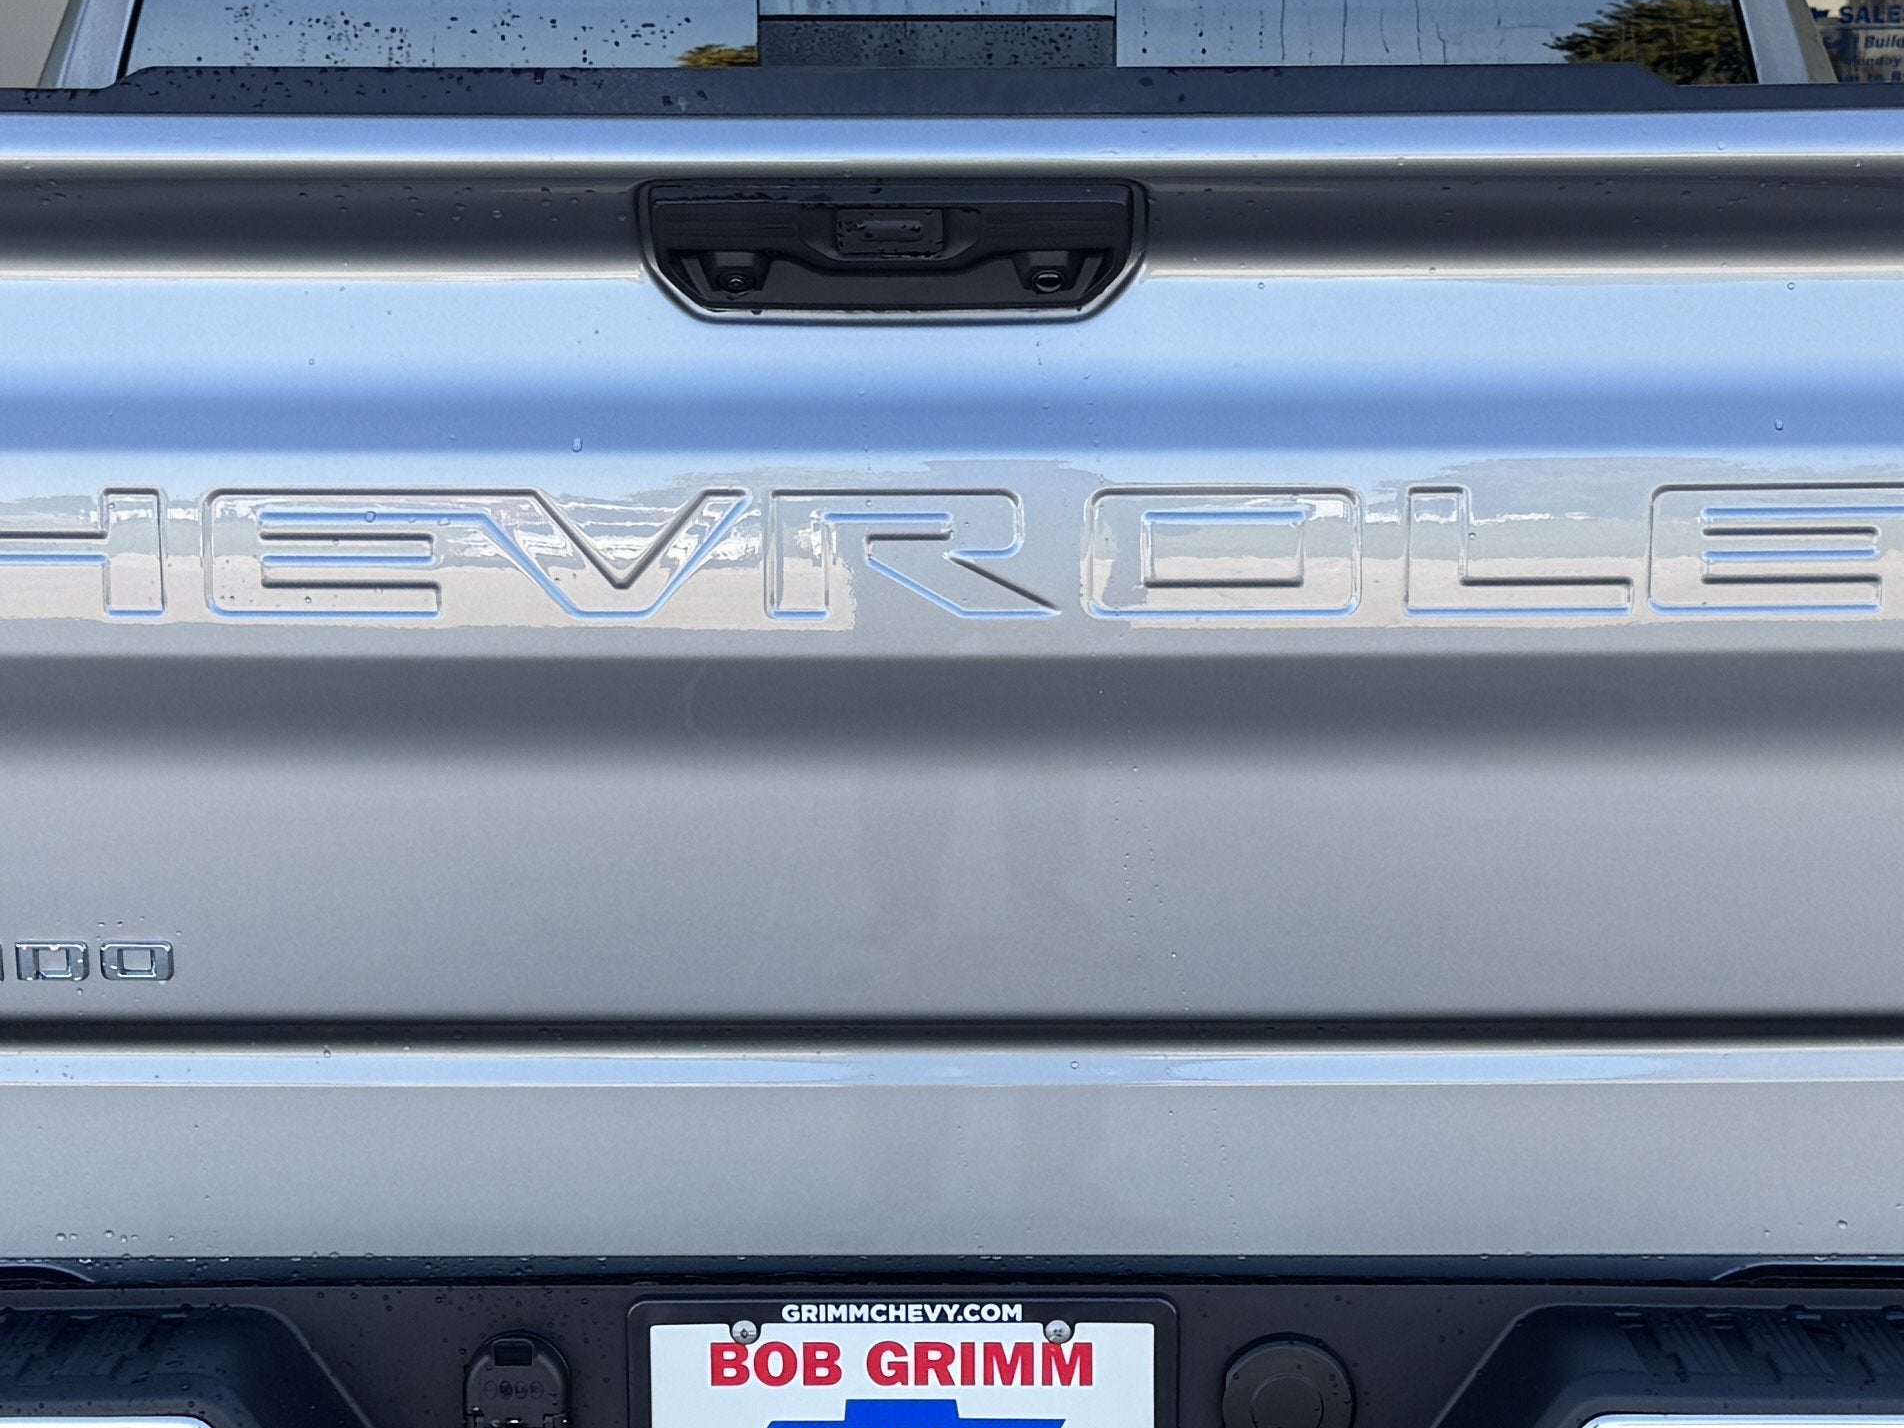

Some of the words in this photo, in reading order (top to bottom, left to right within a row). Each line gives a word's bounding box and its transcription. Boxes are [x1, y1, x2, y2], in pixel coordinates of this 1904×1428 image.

[782, 1304, 1022, 1323] GRIMMCHEVY.COM
[710, 1342, 842, 1387] BOB
[866, 1341, 1094, 1387] GRIMM
